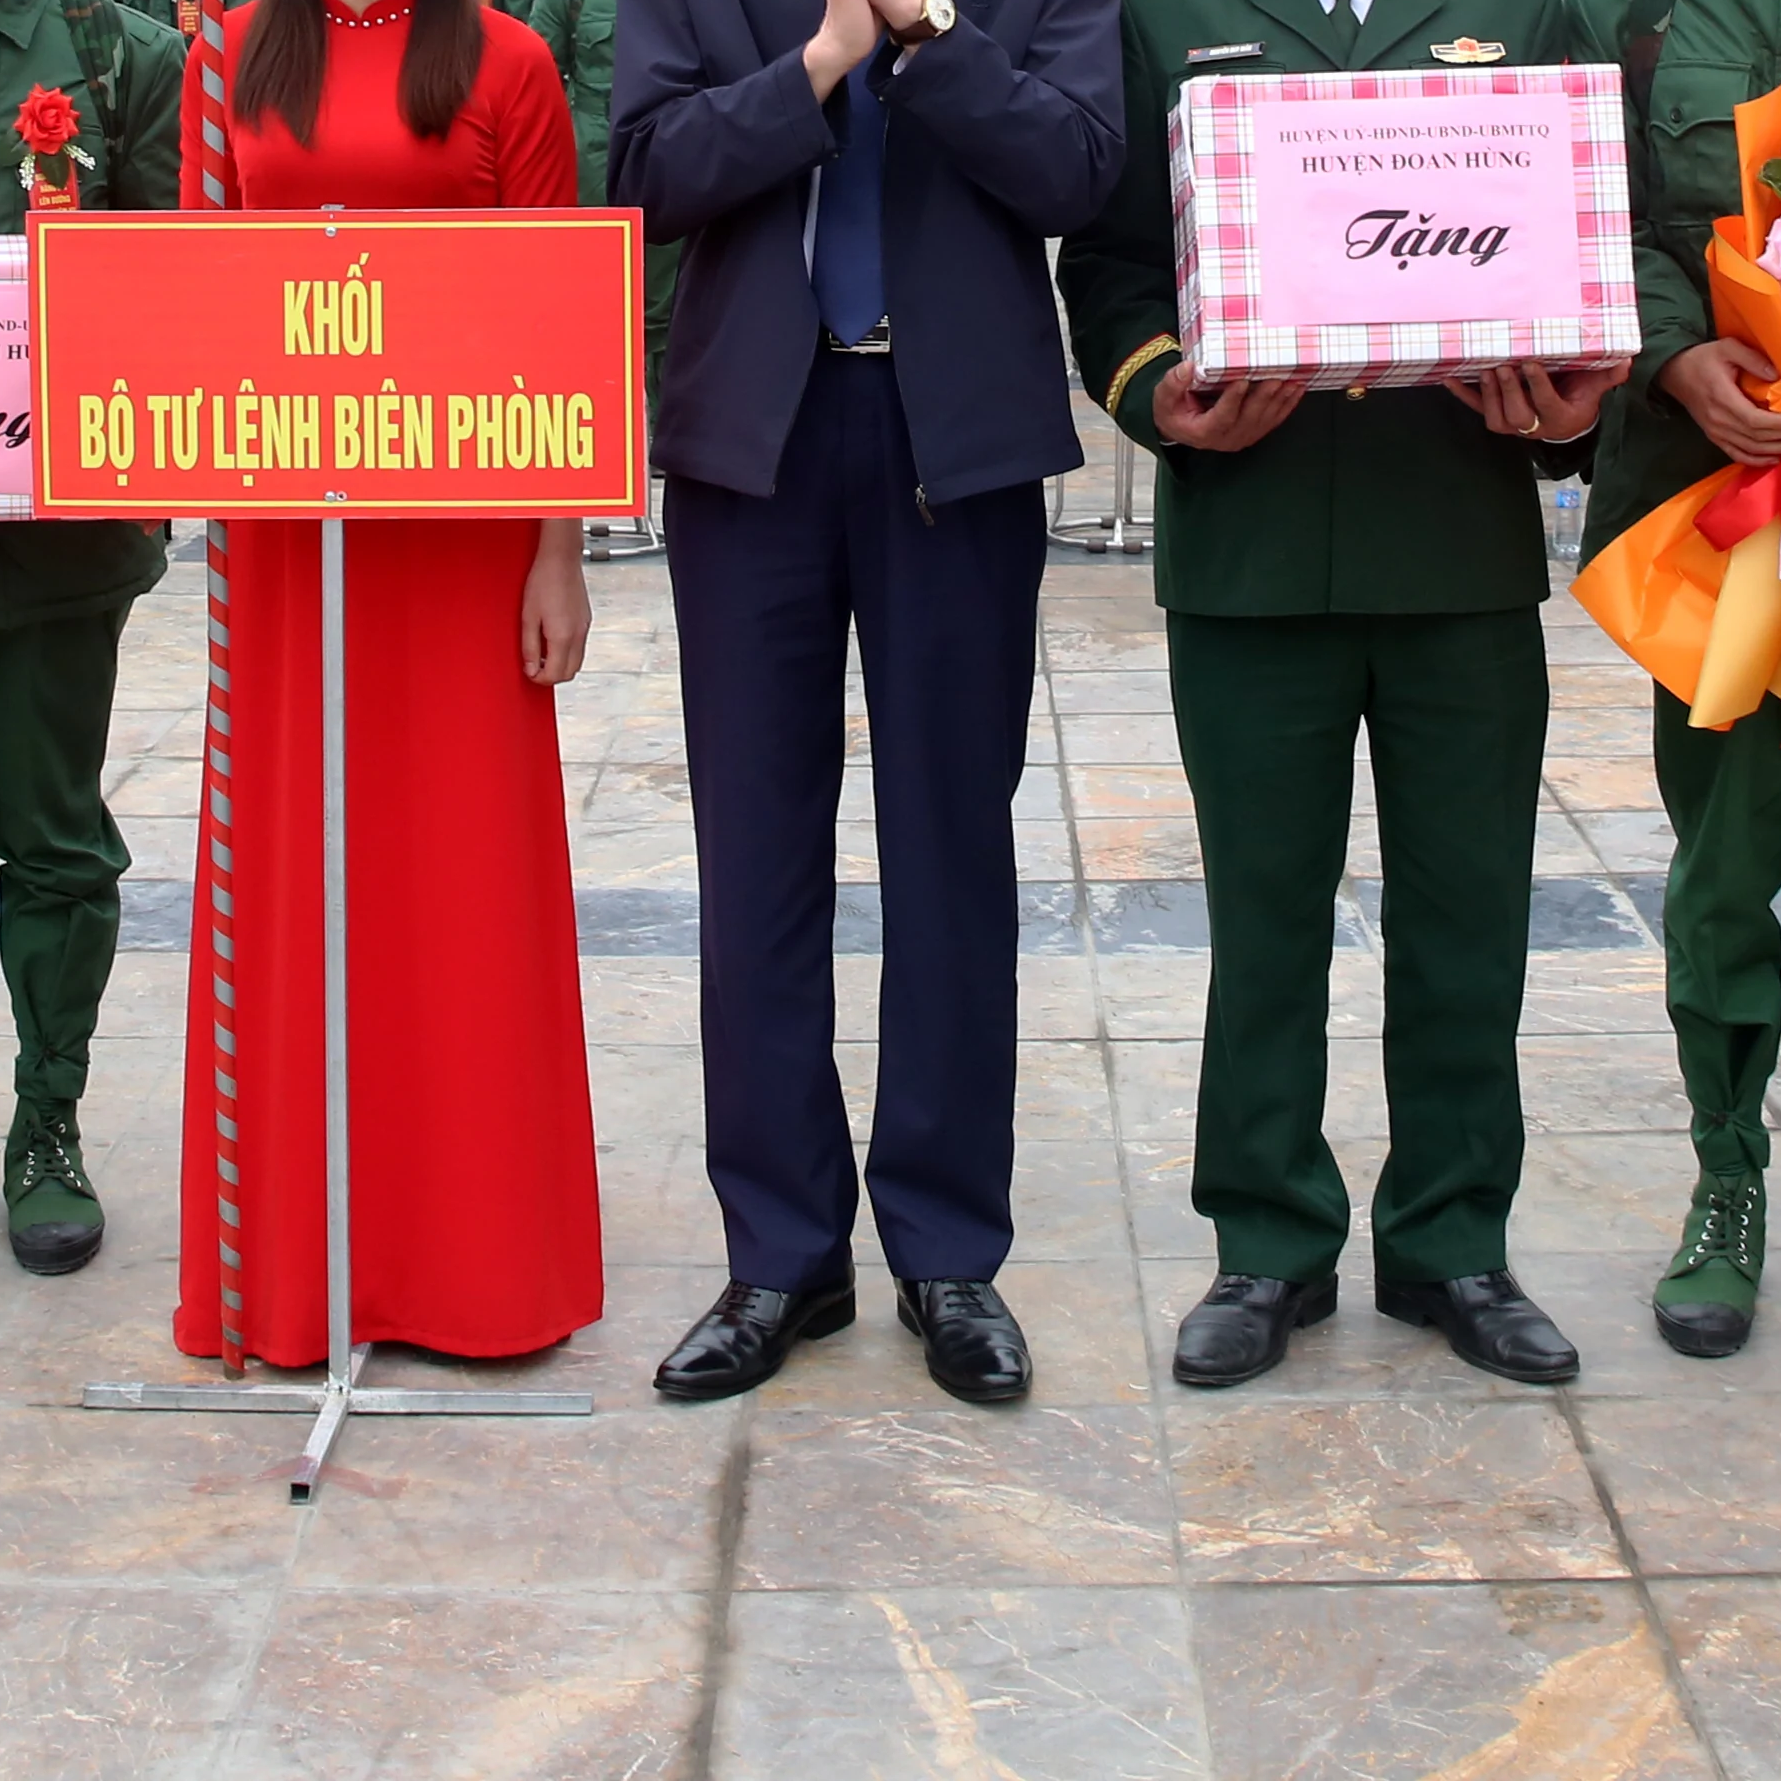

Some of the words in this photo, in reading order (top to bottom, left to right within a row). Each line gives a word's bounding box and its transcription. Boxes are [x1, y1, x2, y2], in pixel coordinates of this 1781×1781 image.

[1279, 129, 1338, 145] HUYỆN
[1302, 152, 1383, 176] HUYỆN
[1391, 151, 1458, 171] ĐOAN
[1465, 146, 1532, 169] HÙNG
[1345, 209, 1511, 271] Tặng
[283, 252, 383, 356] KHỐI
[79, 378, 135, 488] BỘ
[147, 387, 204, 471] TƯ
[213, 378, 320, 488] LỆNH
[334, 378, 434, 470] BIÊN
[447, 375, 595, 471] PHÒNG
